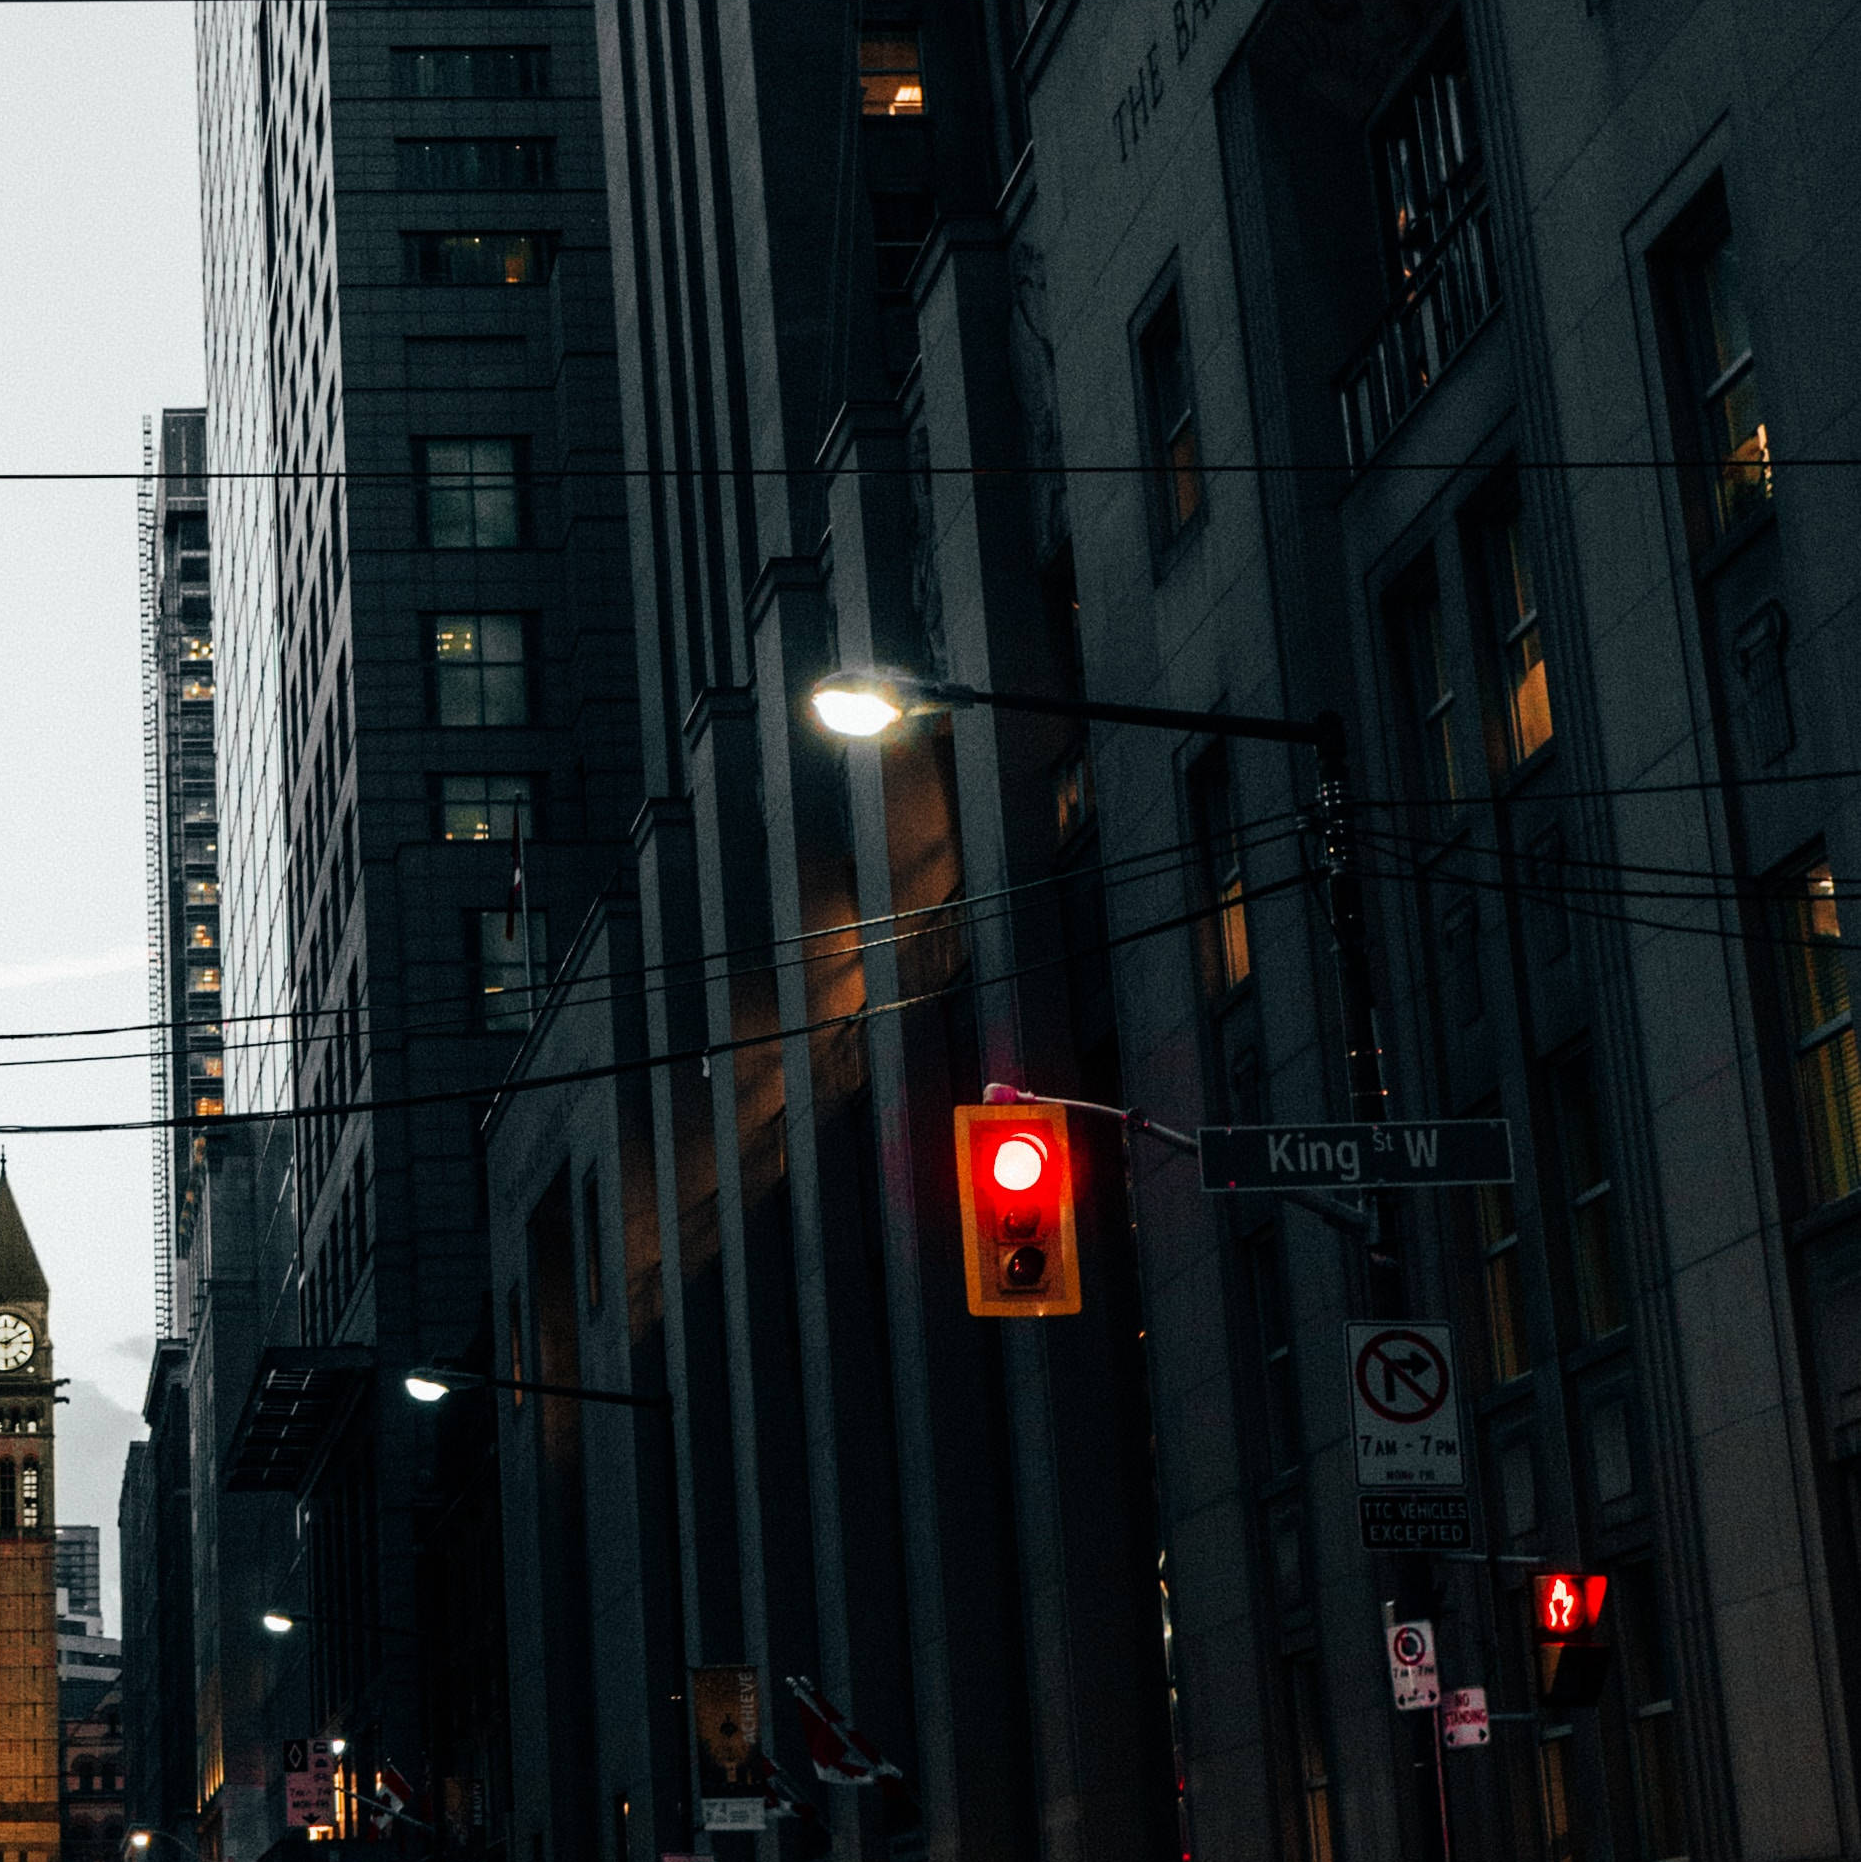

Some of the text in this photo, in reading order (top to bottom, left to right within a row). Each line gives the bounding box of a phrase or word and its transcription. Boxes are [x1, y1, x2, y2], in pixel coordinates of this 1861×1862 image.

[1112, 43, 1164, 164] THE
[1267, 1129, 1438, 1182] King St W
[1361, 1501, 1467, 1520] TTC VEHICLES
[1369, 1523, 1464, 1542] EXCEPTED
[739, 1672, 757, 1745] ACHIEVE
